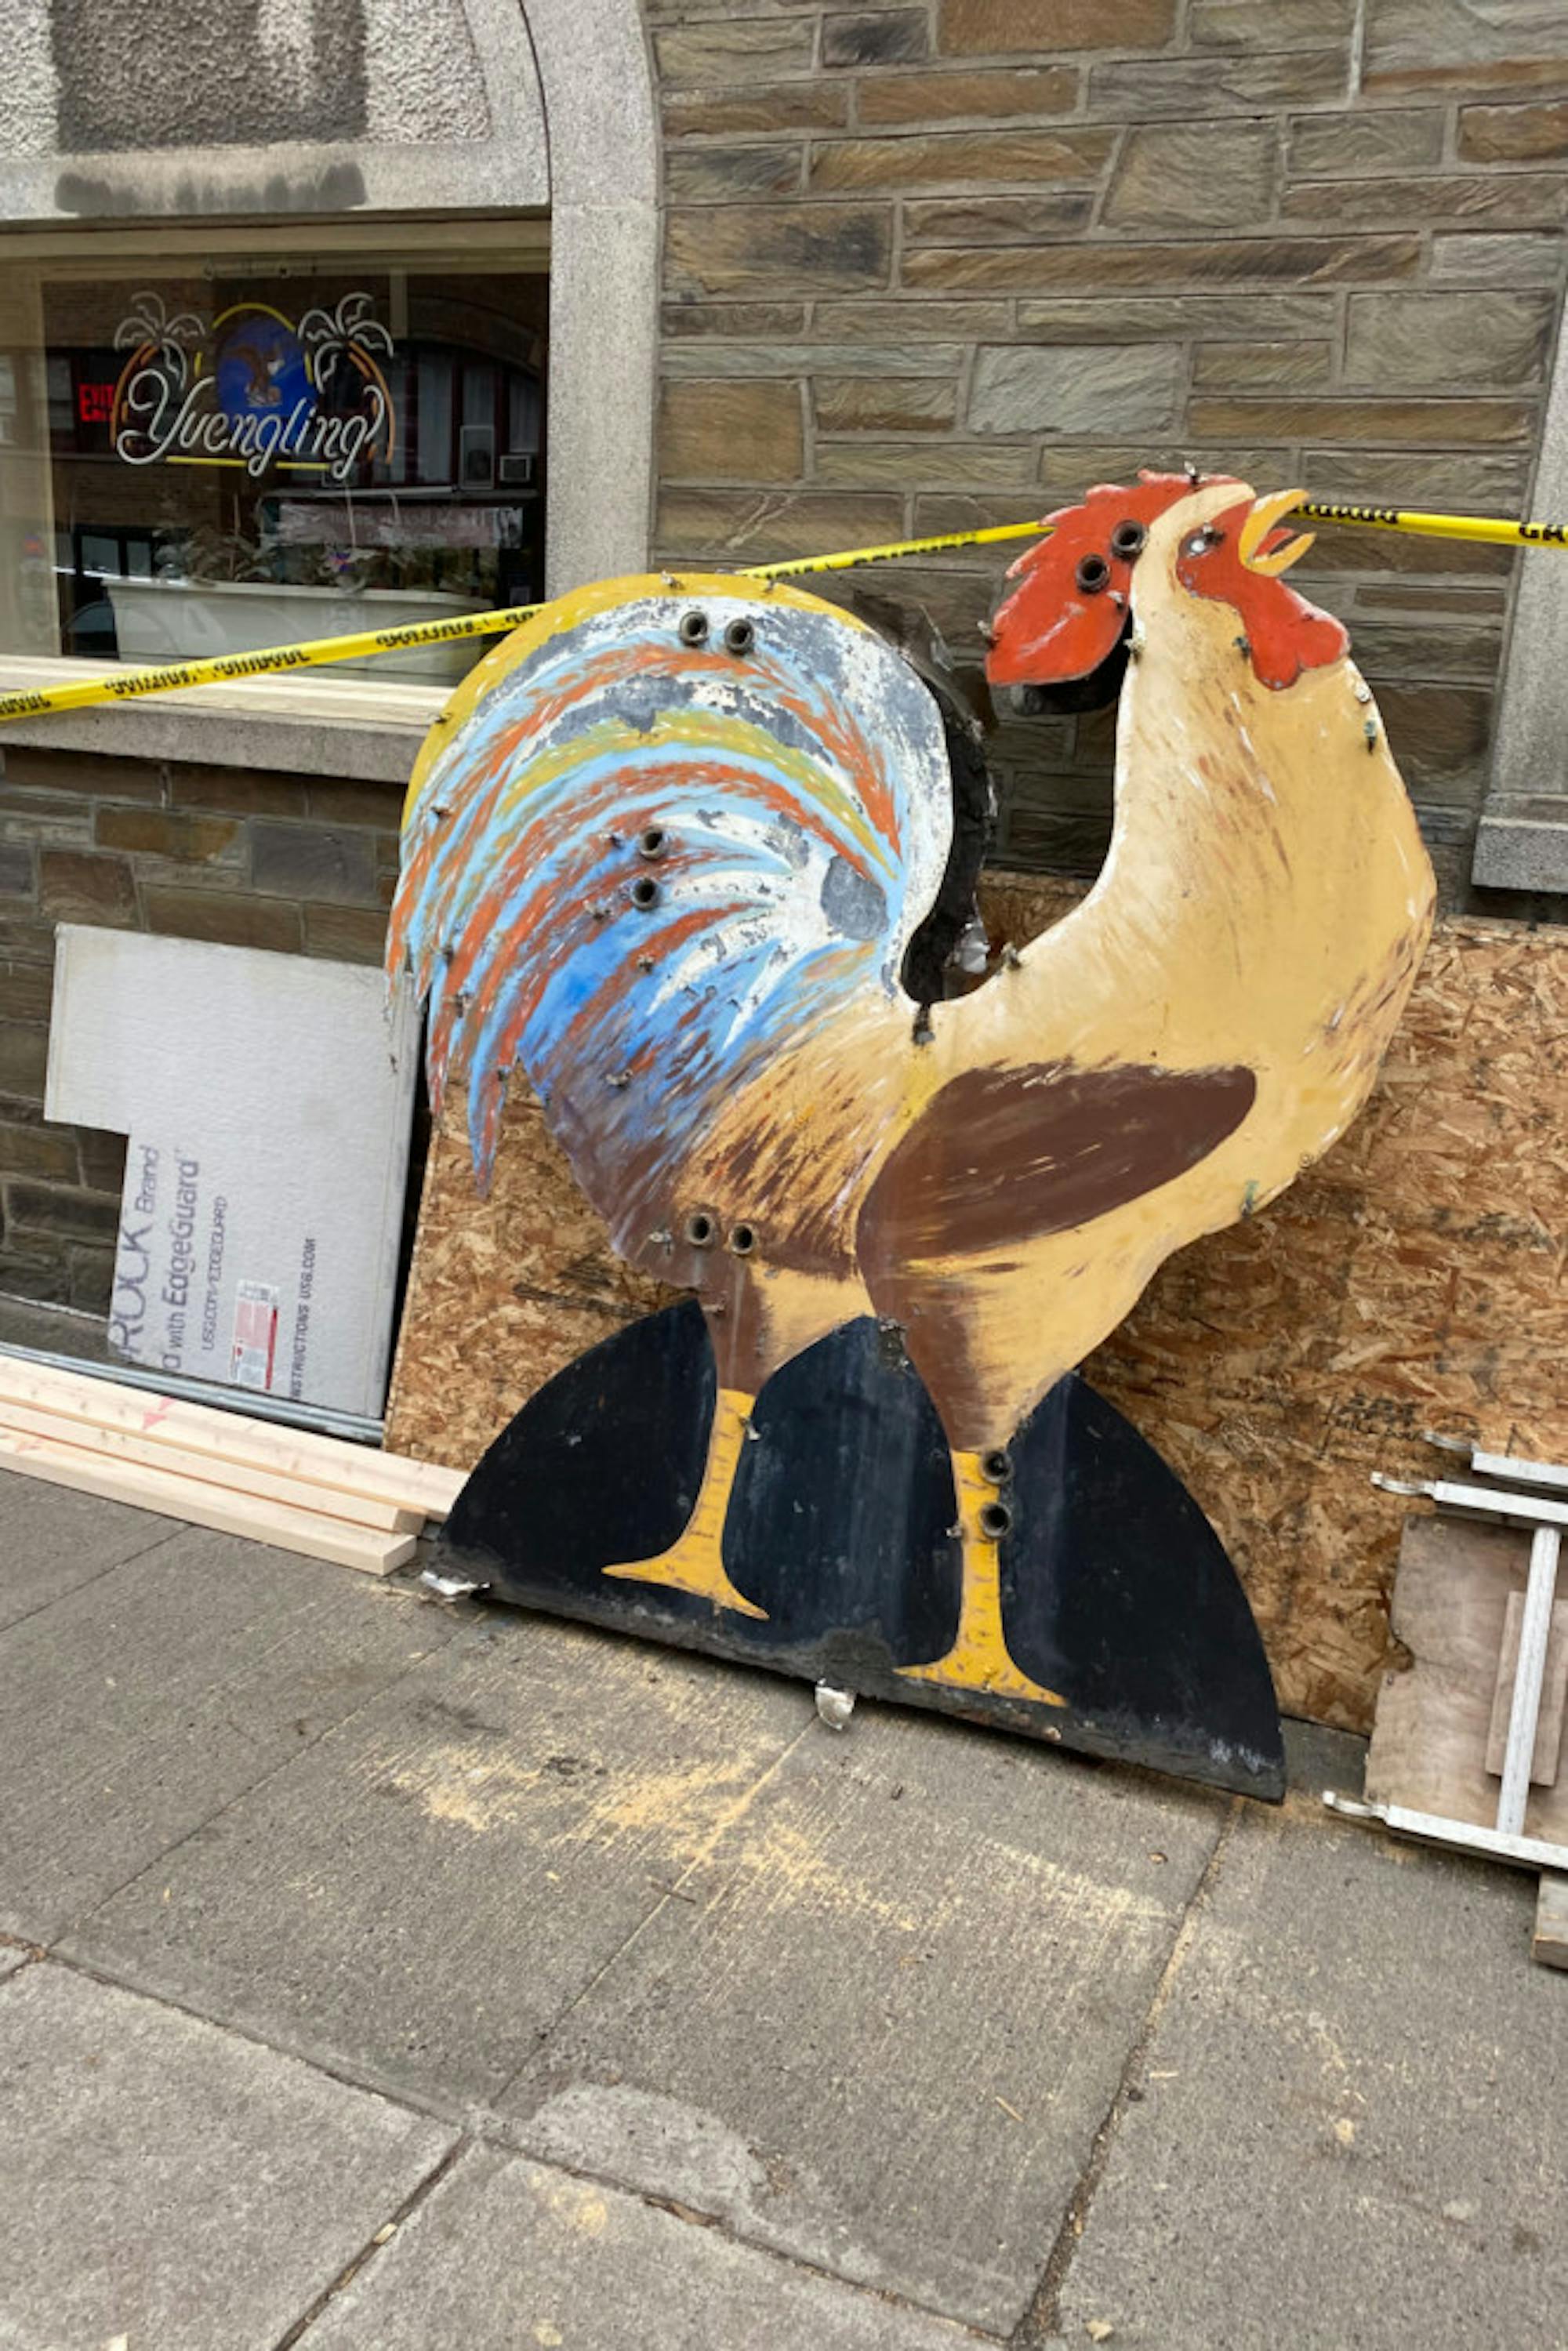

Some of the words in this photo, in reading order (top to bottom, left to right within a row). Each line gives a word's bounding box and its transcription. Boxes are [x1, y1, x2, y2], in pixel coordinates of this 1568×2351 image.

[117, 368, 384, 479] Yuengling
[113, 1222, 153, 1360] ROCK
[135, 1144, 160, 1214] Brand
[162, 1159, 200, 1307] EdgeGuard
[298, 1238, 316, 1299] USG.COM
[167, 1312, 186, 1348] with
[290, 1303, 310, 1399] NSTRUCTIONS
